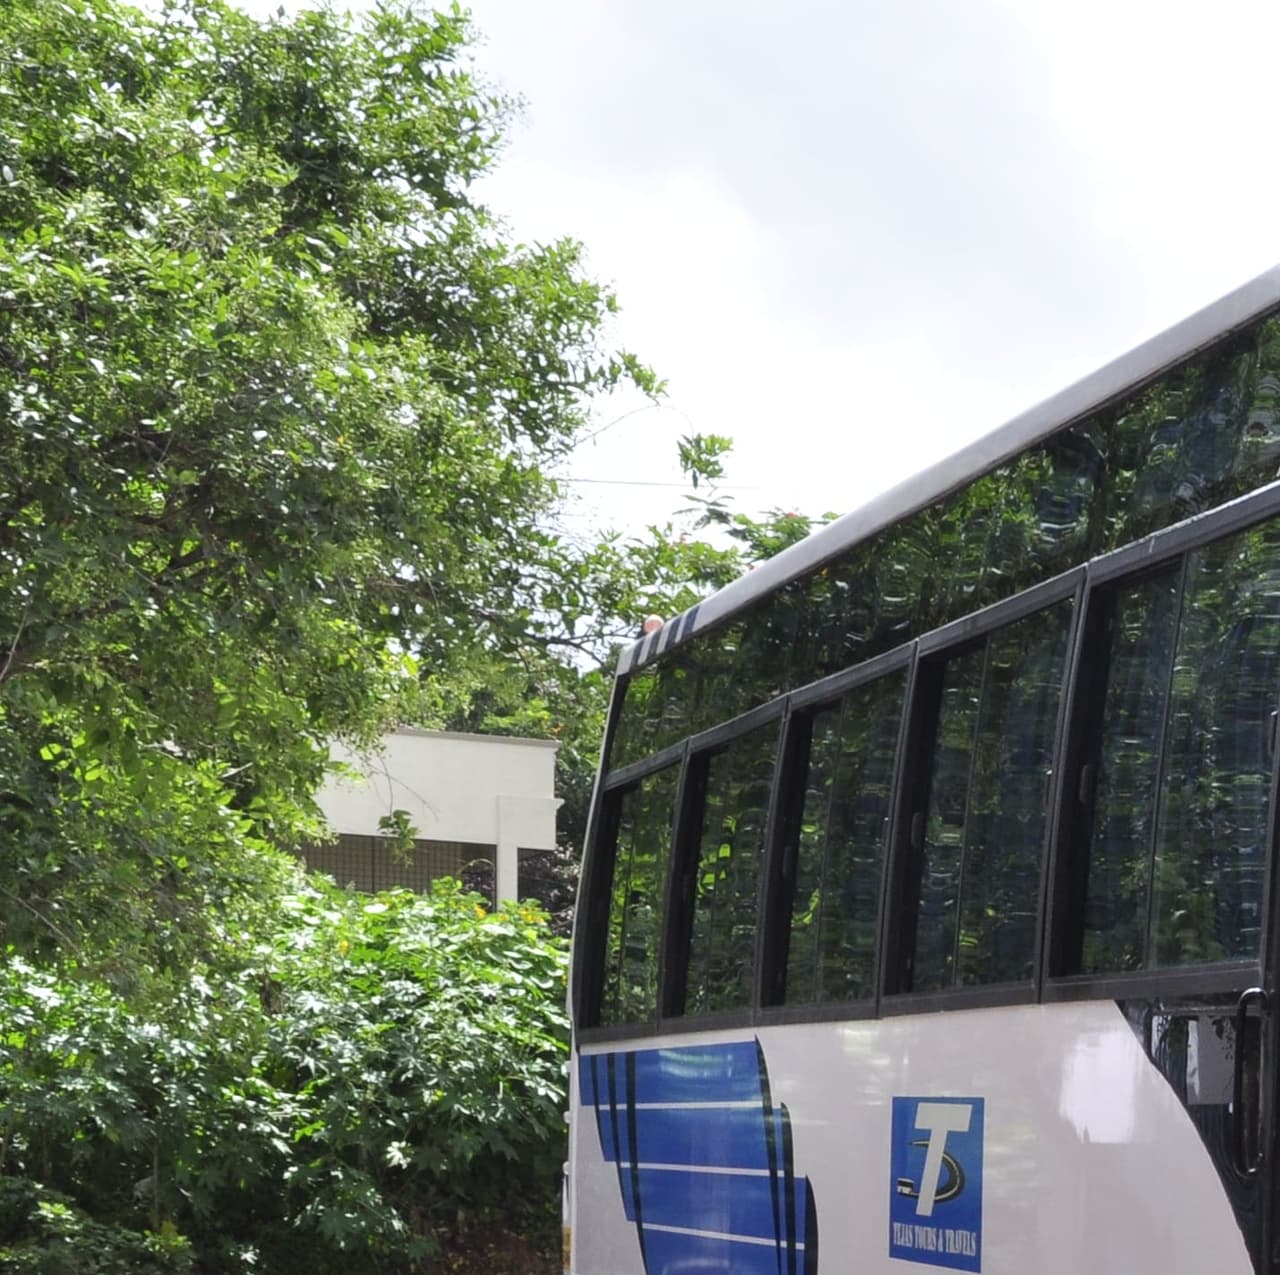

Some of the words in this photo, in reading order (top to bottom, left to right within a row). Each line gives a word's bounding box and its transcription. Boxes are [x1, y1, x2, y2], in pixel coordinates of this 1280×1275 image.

[893, 1222, 913, 1247] TEJAS
[915, 1225, 937, 1251] TOURS
[945, 1229, 977, 1256] TRAVELS
